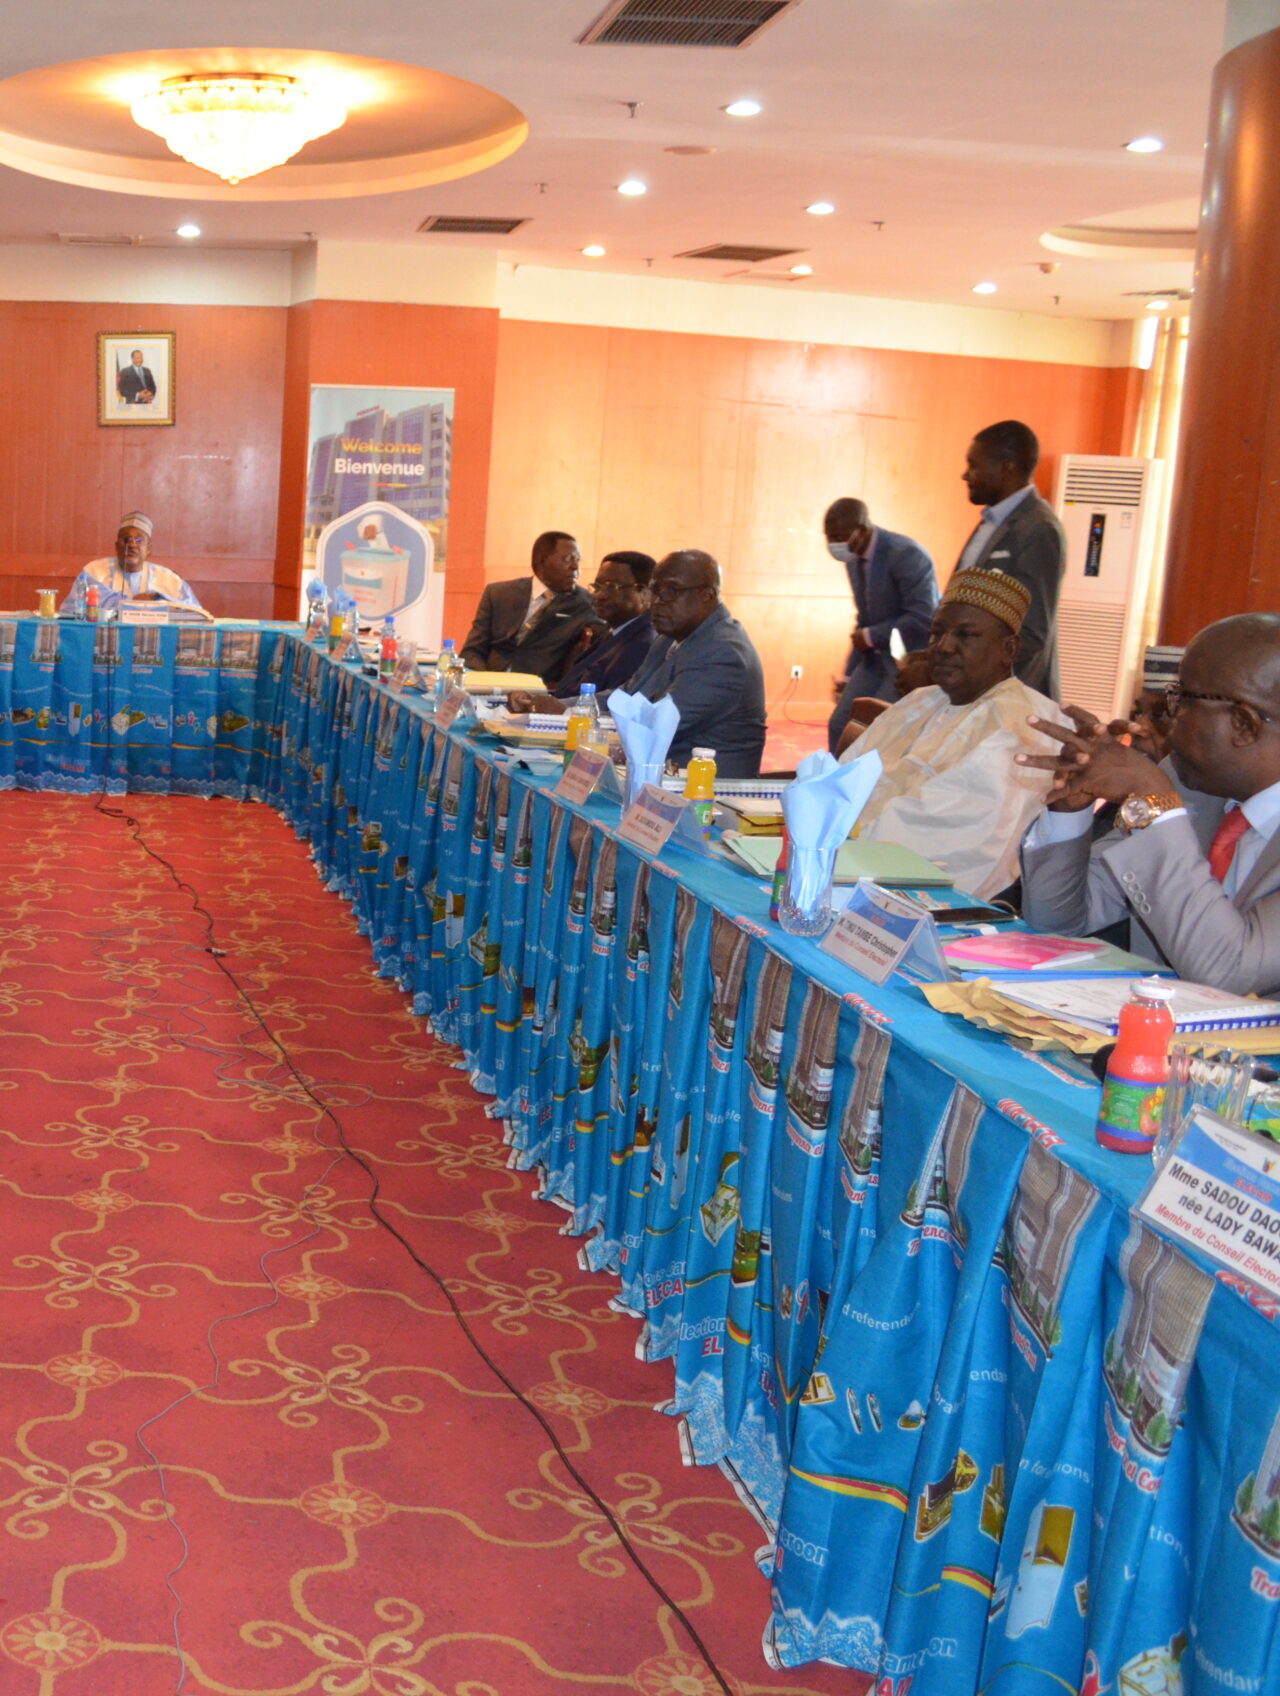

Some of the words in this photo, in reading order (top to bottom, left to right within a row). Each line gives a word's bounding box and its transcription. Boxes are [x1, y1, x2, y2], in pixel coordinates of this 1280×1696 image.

[334, 458, 425, 475] Bienvenue
[340, 438, 424, 454] Welcome
[1167, 1163, 1199, 1190] Mme
[1200, 1181, 1251, 1216] SADOU
[1250, 1208, 1280, 1236] DAO
[1178, 1194, 1203, 1215] née
[1204, 1208, 1243, 1237] LADY
[1155, 1204, 1192, 1232] Membre
[1192, 1225, 1205, 1240] du
[1206, 1233, 1245, 1262] Conseil
